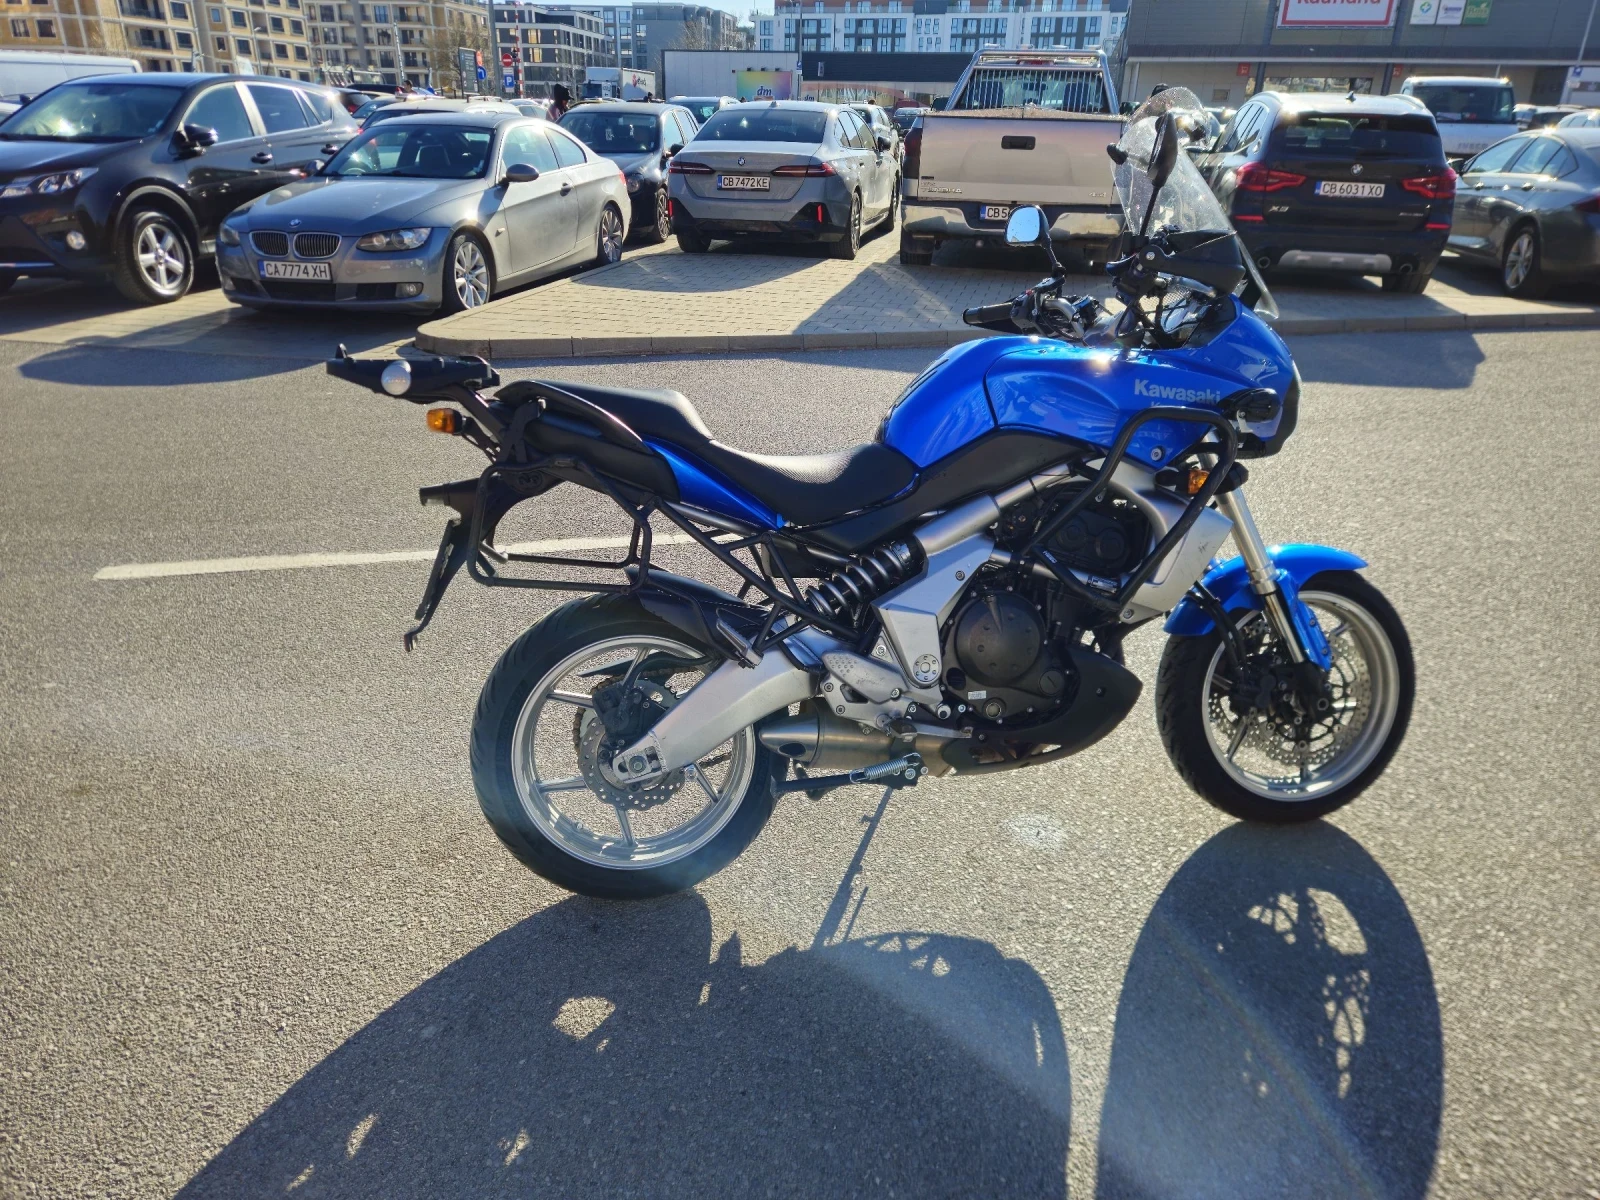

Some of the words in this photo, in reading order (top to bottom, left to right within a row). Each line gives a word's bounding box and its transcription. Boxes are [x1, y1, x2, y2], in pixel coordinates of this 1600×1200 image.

[506, 77, 513, 86] P
[757, 86, 772, 96] dm
[723, 177, 734, 187] CB
[735, 177, 756, 188] 7472
[756, 178, 768, 188] KE
[1322, 182, 1337, 194] CB
[1339, 183, 1365, 195] 6031
[1367, 185, 1383, 197] XO
[987, 207, 999, 218] CB
[265, 263, 281, 277] CA
[281, 263, 310, 278] 7774
[311, 265, 328, 279] XH
[1134, 378, 1221, 404] Kawasaki
